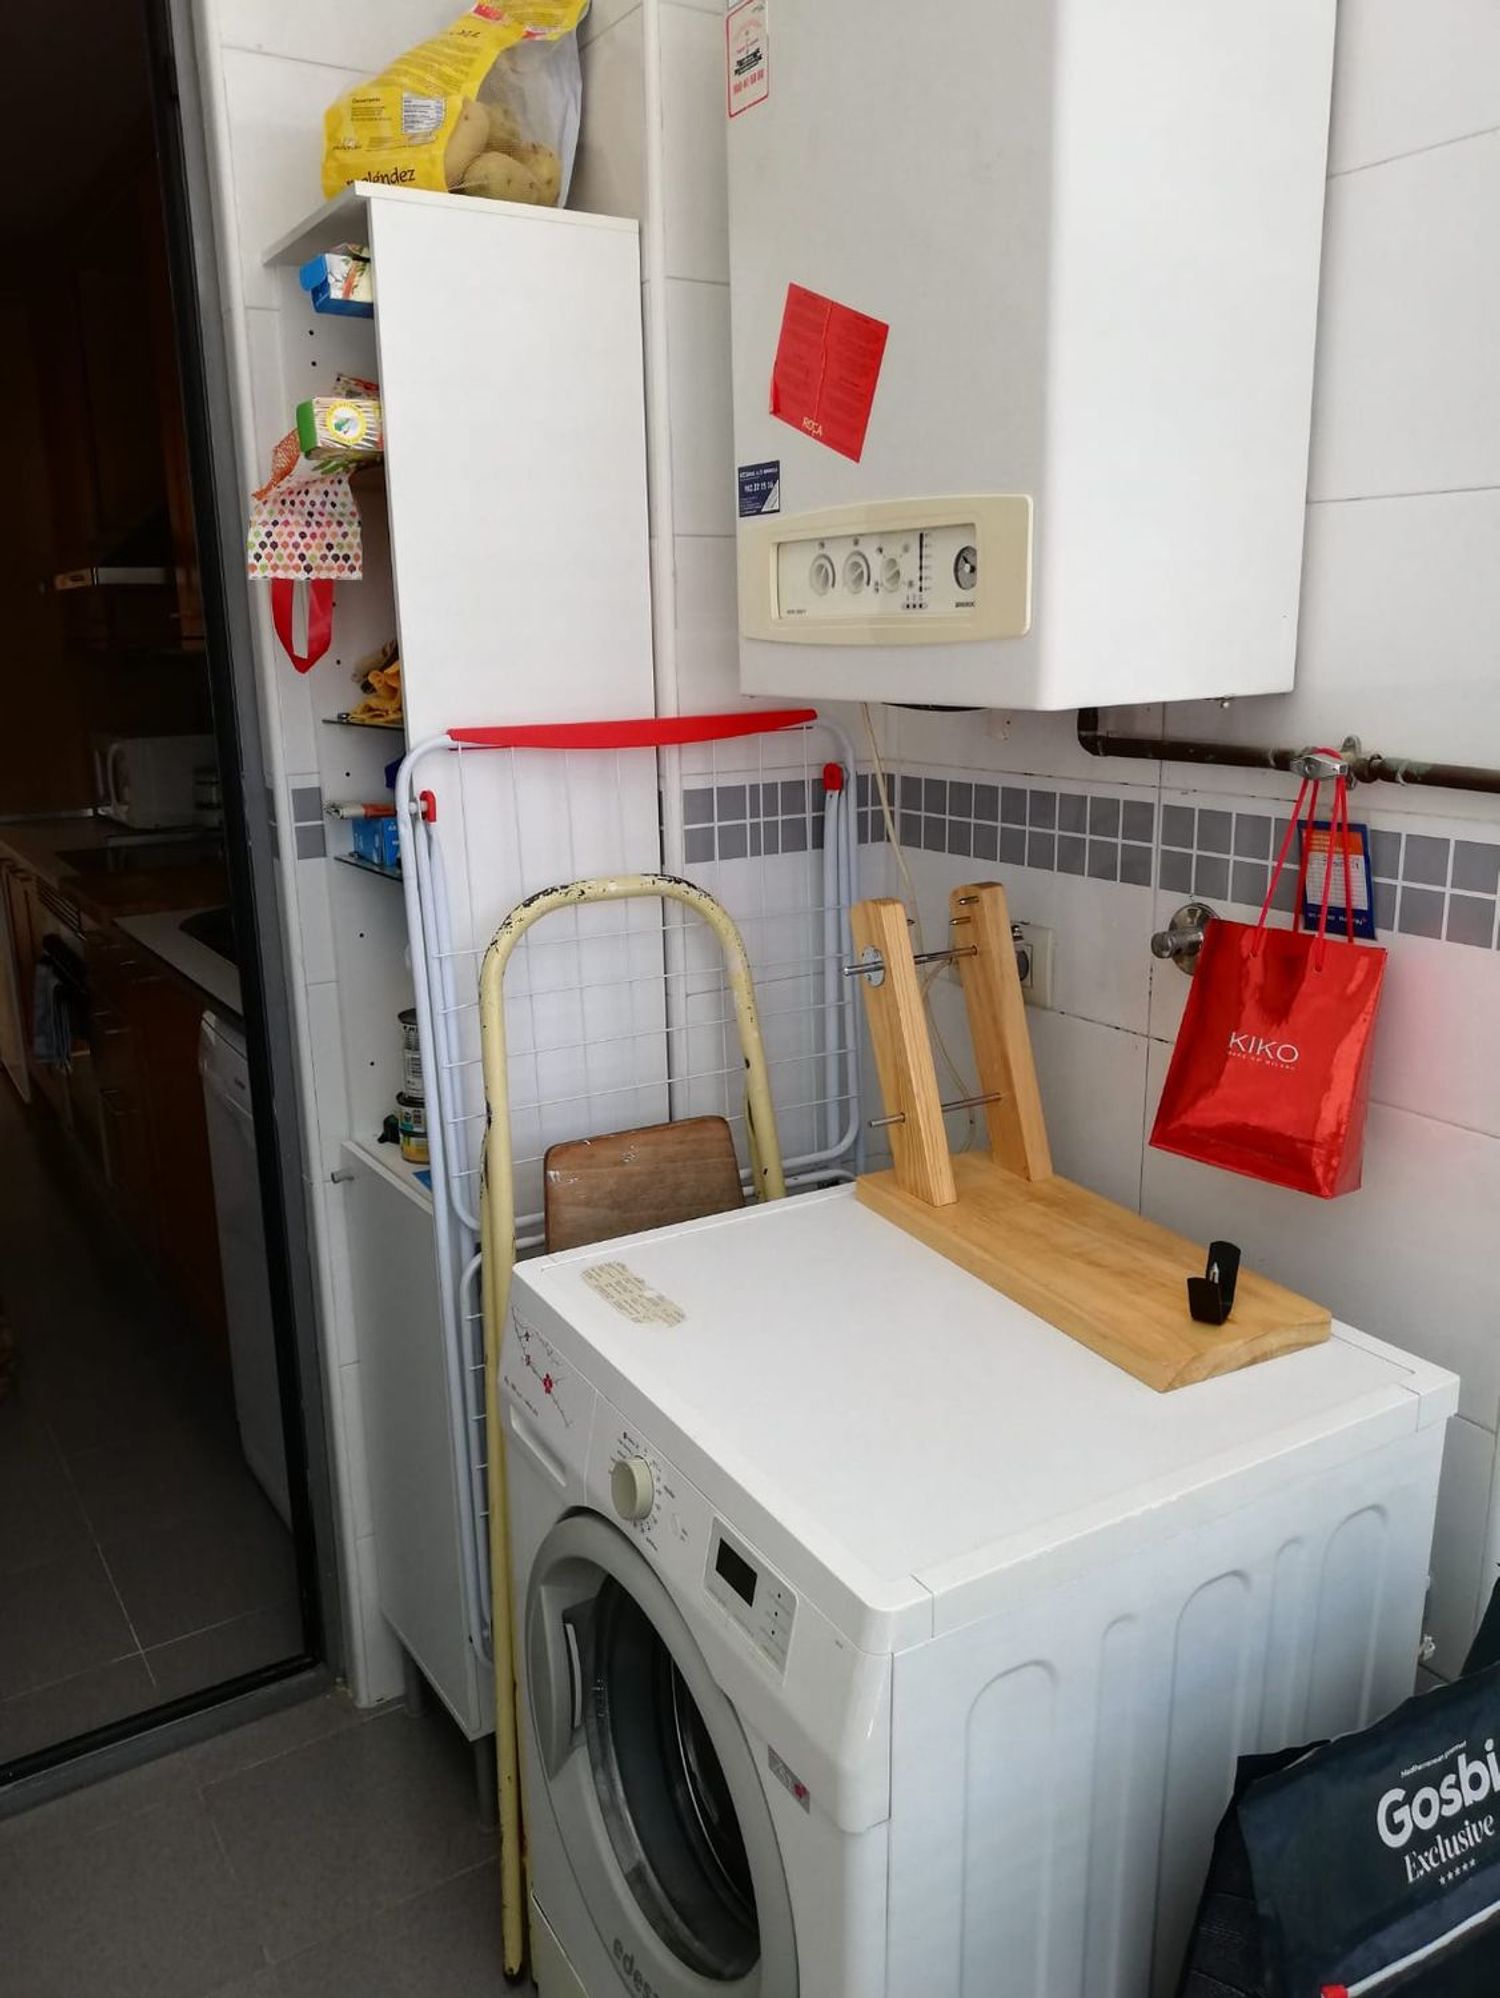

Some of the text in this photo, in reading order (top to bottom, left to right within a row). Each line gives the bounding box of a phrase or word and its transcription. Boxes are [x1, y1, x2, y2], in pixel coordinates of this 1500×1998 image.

[346, 167, 416, 186] léndez
[1229, 1031, 1299, 1063] KIKO
[1377, 1738, 1500, 1848] Gosbi
[1404, 1814, 1495, 1883] Exclusive
[613, 1938, 660, 1998] edes
